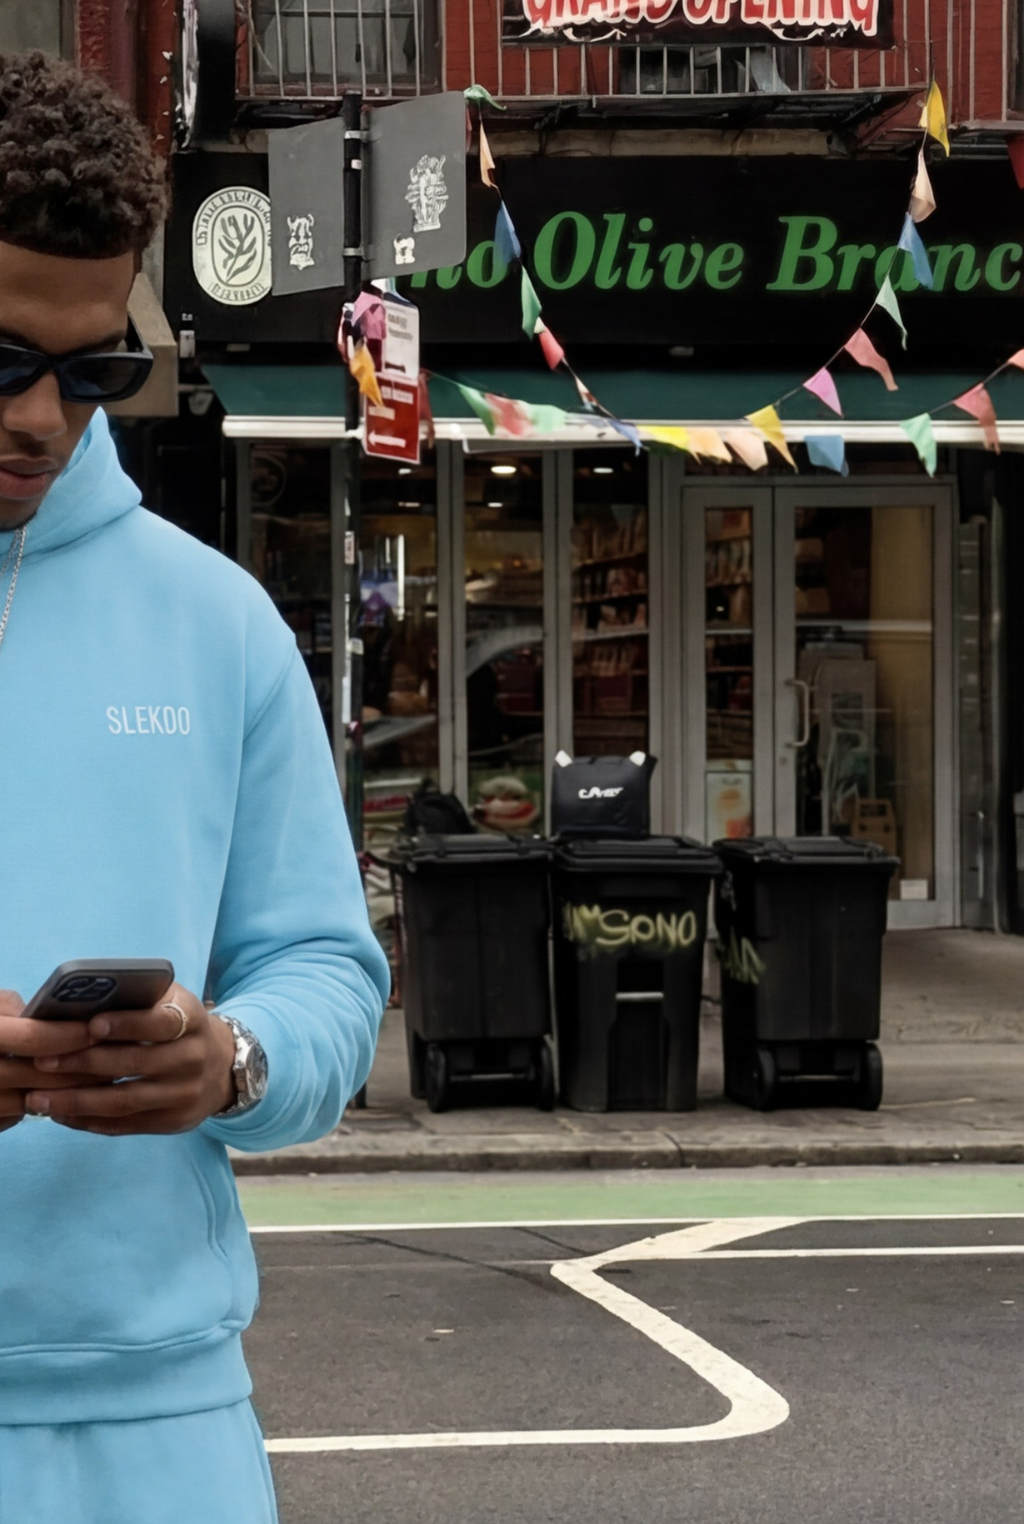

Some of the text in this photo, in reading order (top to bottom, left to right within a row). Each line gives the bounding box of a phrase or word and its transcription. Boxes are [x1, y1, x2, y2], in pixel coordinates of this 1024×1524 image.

[533, 211, 744, 290] Olive
[765, 215, 1023, 292] Branc
[106, 705, 191, 735] SLEKOO
